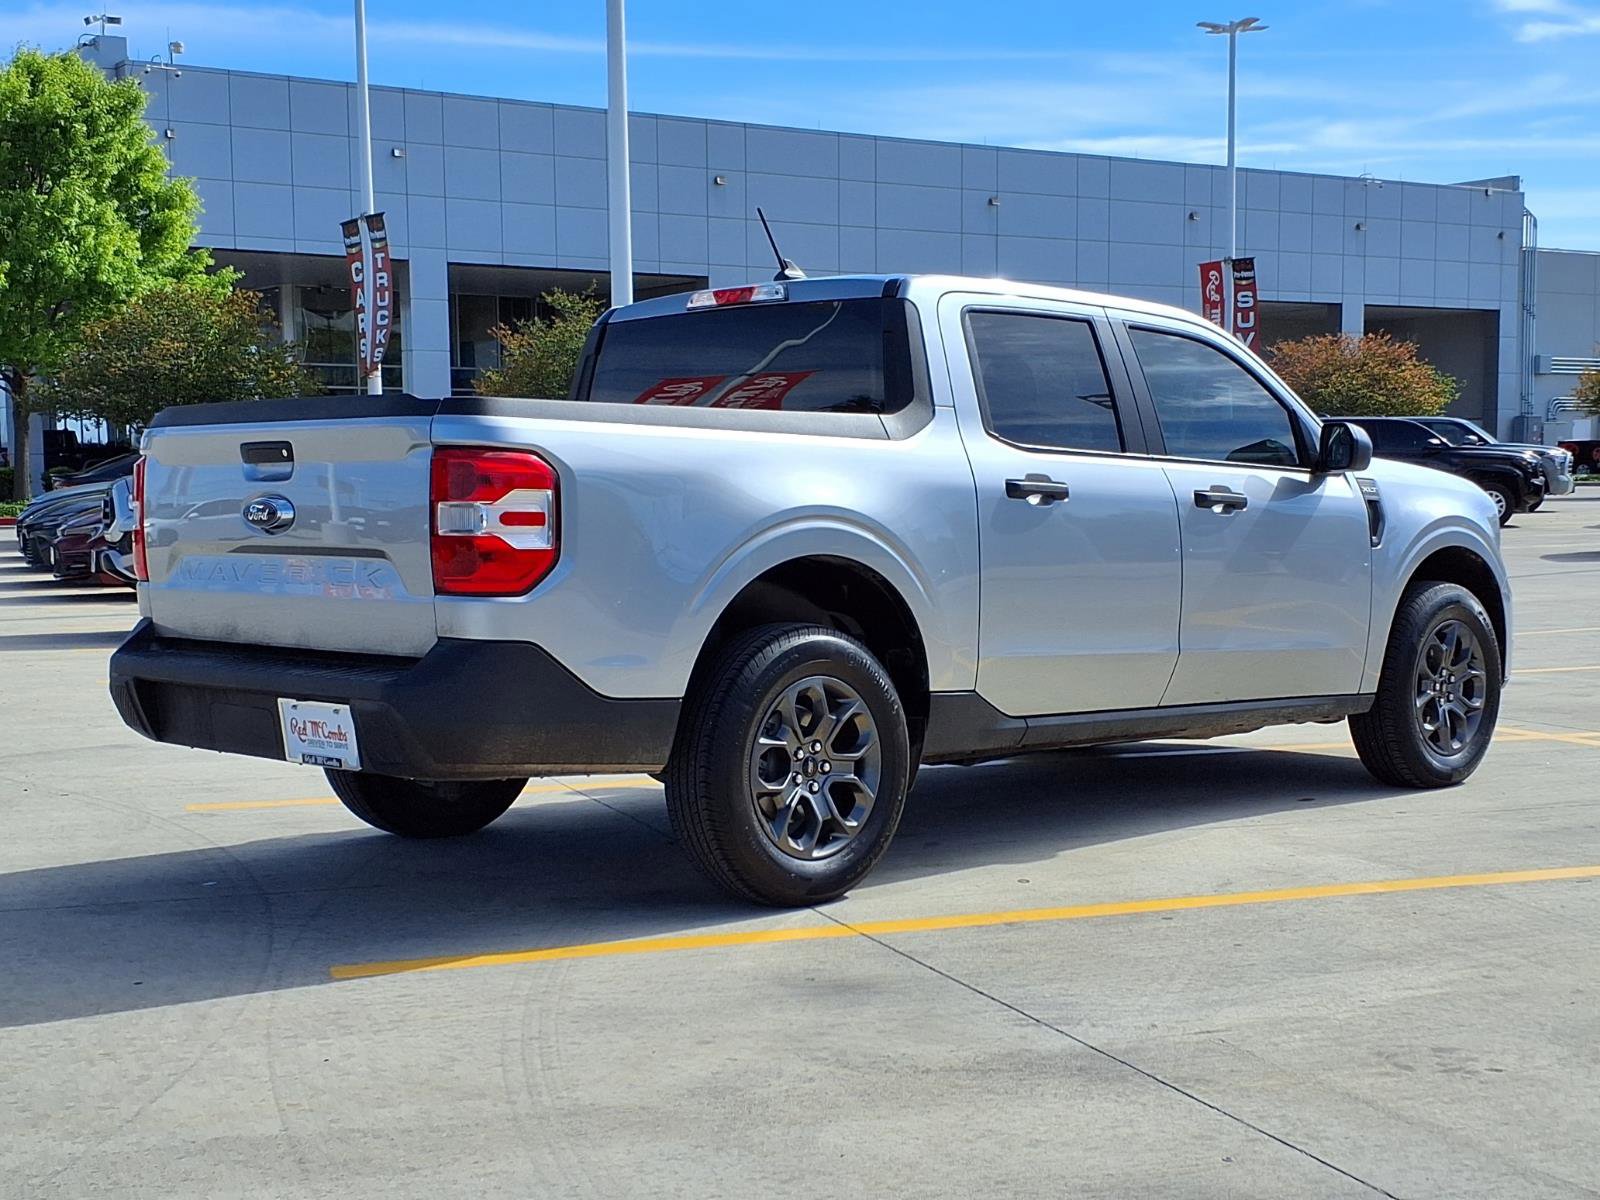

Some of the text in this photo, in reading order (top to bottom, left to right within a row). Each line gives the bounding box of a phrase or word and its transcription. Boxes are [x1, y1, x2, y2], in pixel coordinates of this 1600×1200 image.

[351, 261, 366, 358] CARS
[373, 253, 388, 362] TRUCKS
[247, 504, 268, 521] Ford
[177, 558, 384, 588] MAVERICK
[290, 717, 307, 743] Red
